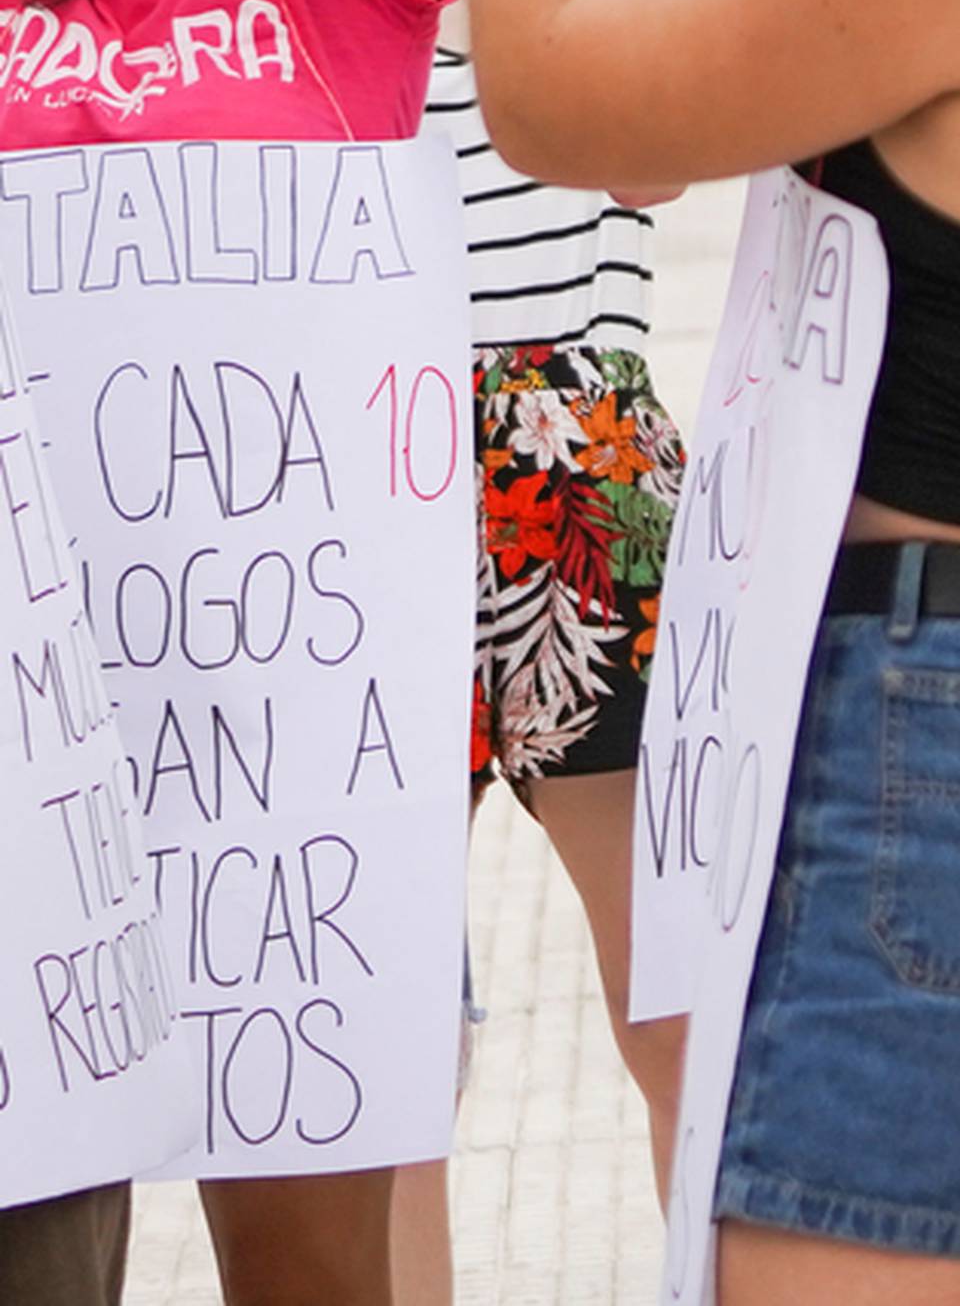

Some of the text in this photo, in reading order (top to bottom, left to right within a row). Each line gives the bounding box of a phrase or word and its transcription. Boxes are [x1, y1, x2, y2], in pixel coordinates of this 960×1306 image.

[94, 361, 334, 523] CADA
[365, 363, 457, 502] 10
[346, 677, 405, 796] A
[180, 998, 363, 1155] TOS
